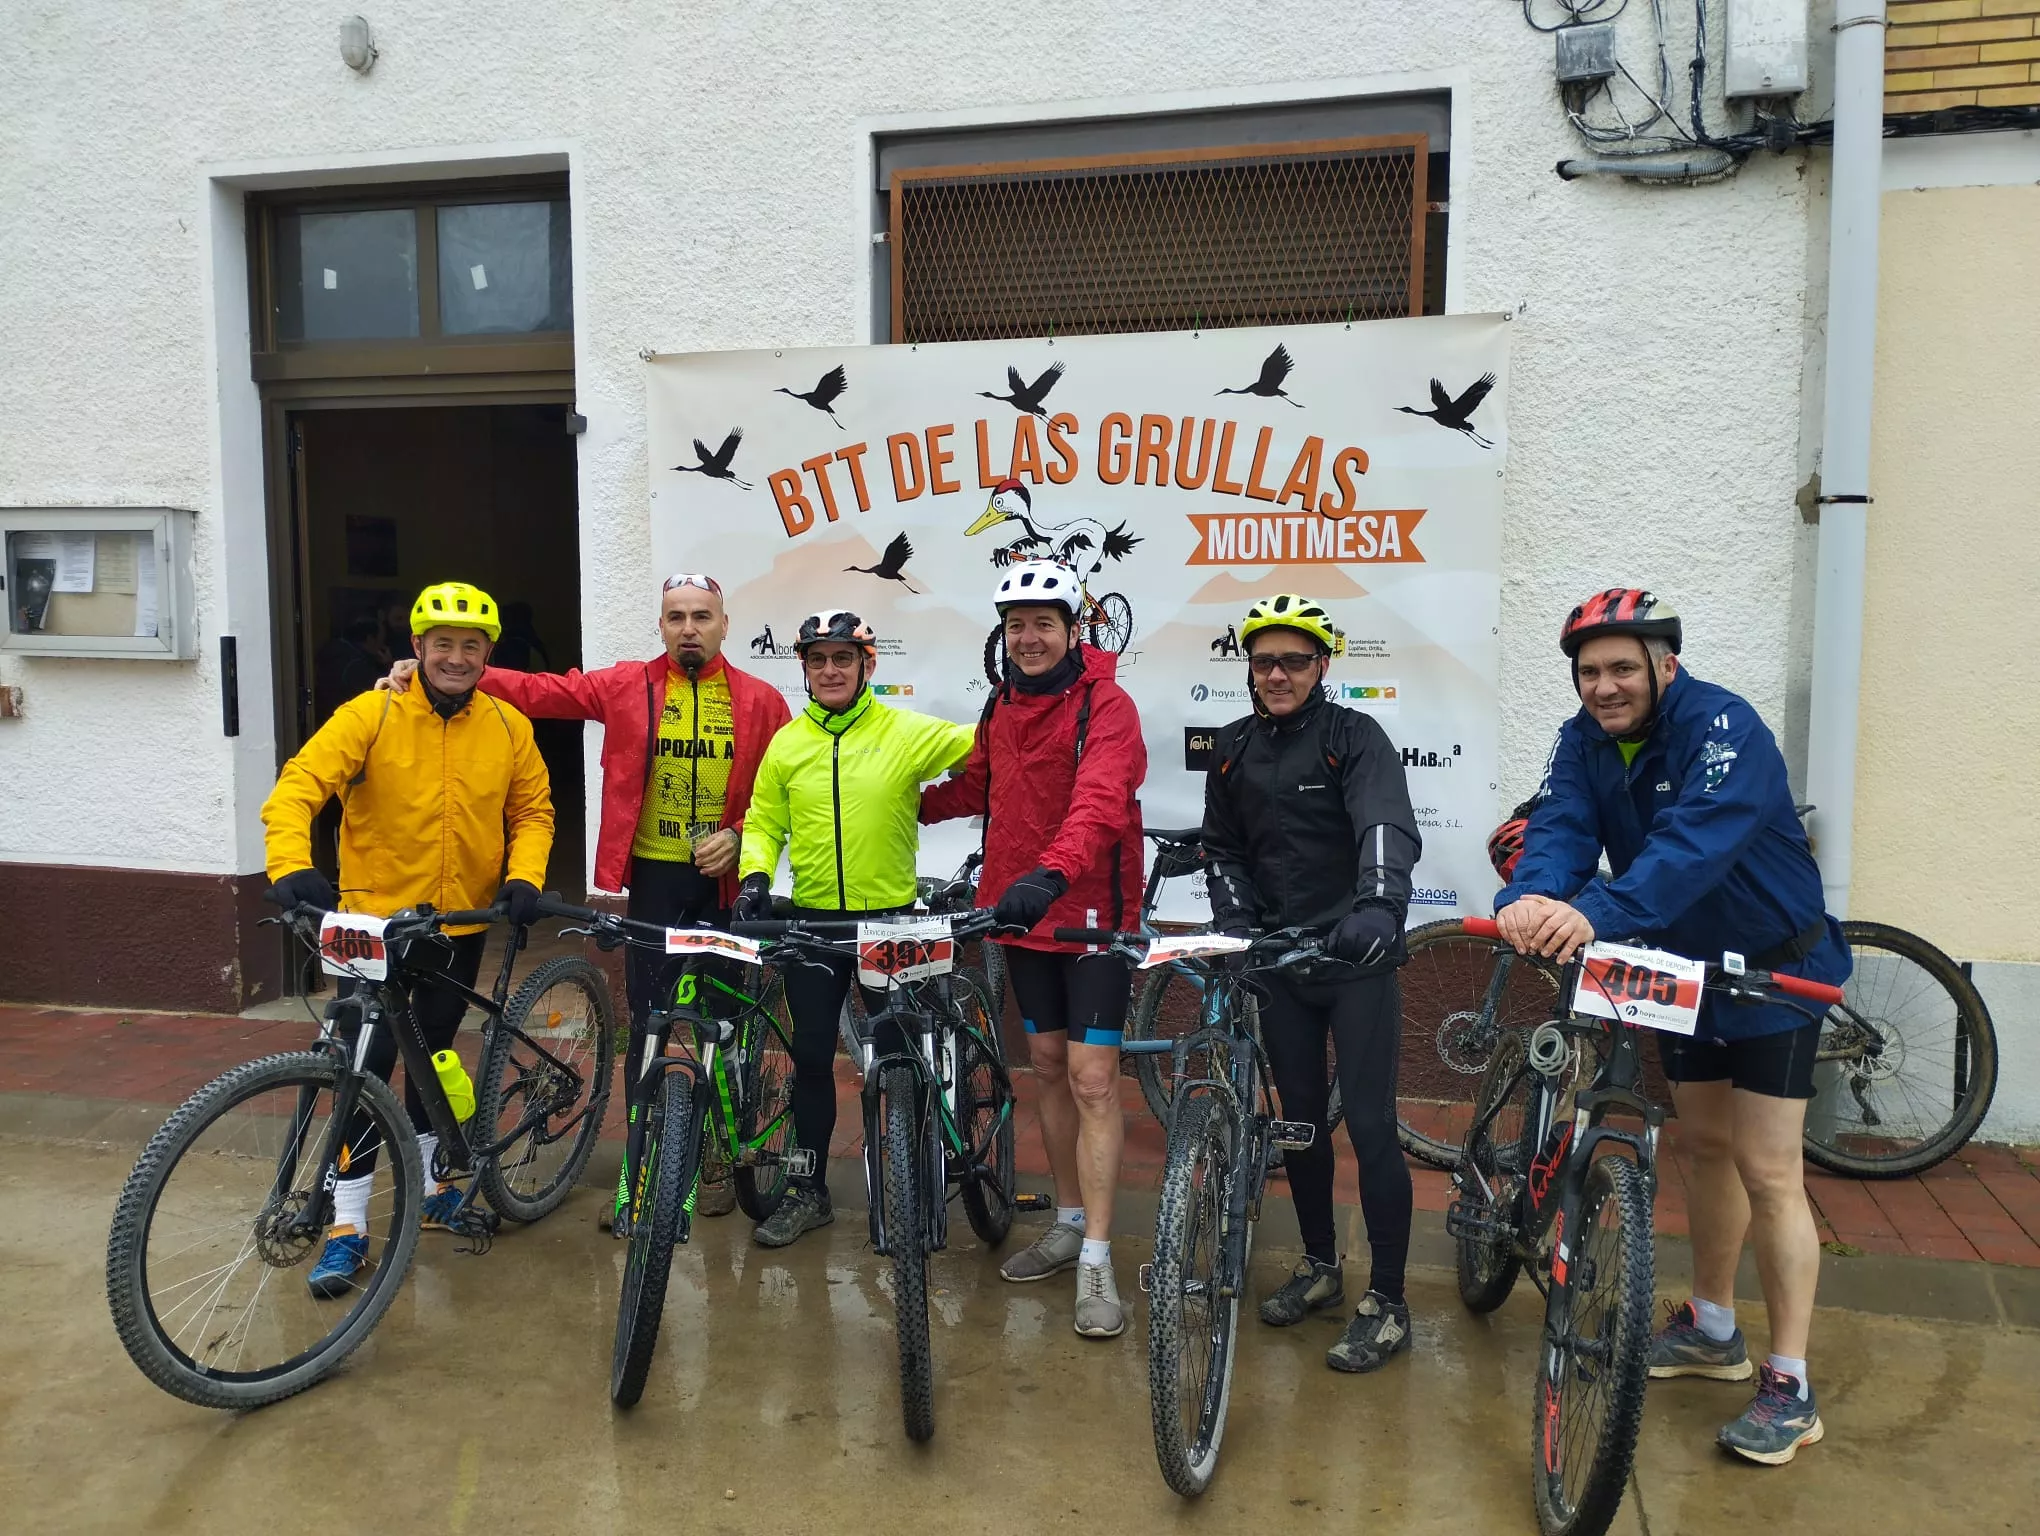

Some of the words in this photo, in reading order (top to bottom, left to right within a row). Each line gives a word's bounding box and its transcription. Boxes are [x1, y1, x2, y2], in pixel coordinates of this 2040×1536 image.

[768, 442, 872, 538] BTT
[887, 423, 961, 503] DE
[975, 412, 1080, 490] LAS
[1098, 411, 1370, 521] GRULLAS
[1207, 515, 1402, 561] MONTMESA
[1211, 689, 1235, 699] hoya
[1413, 806, 1440, 817] rupo
[659, 819, 681, 840] BAR
[876, 938, 936, 970] 392
[1601, 960, 1679, 1006] 405
